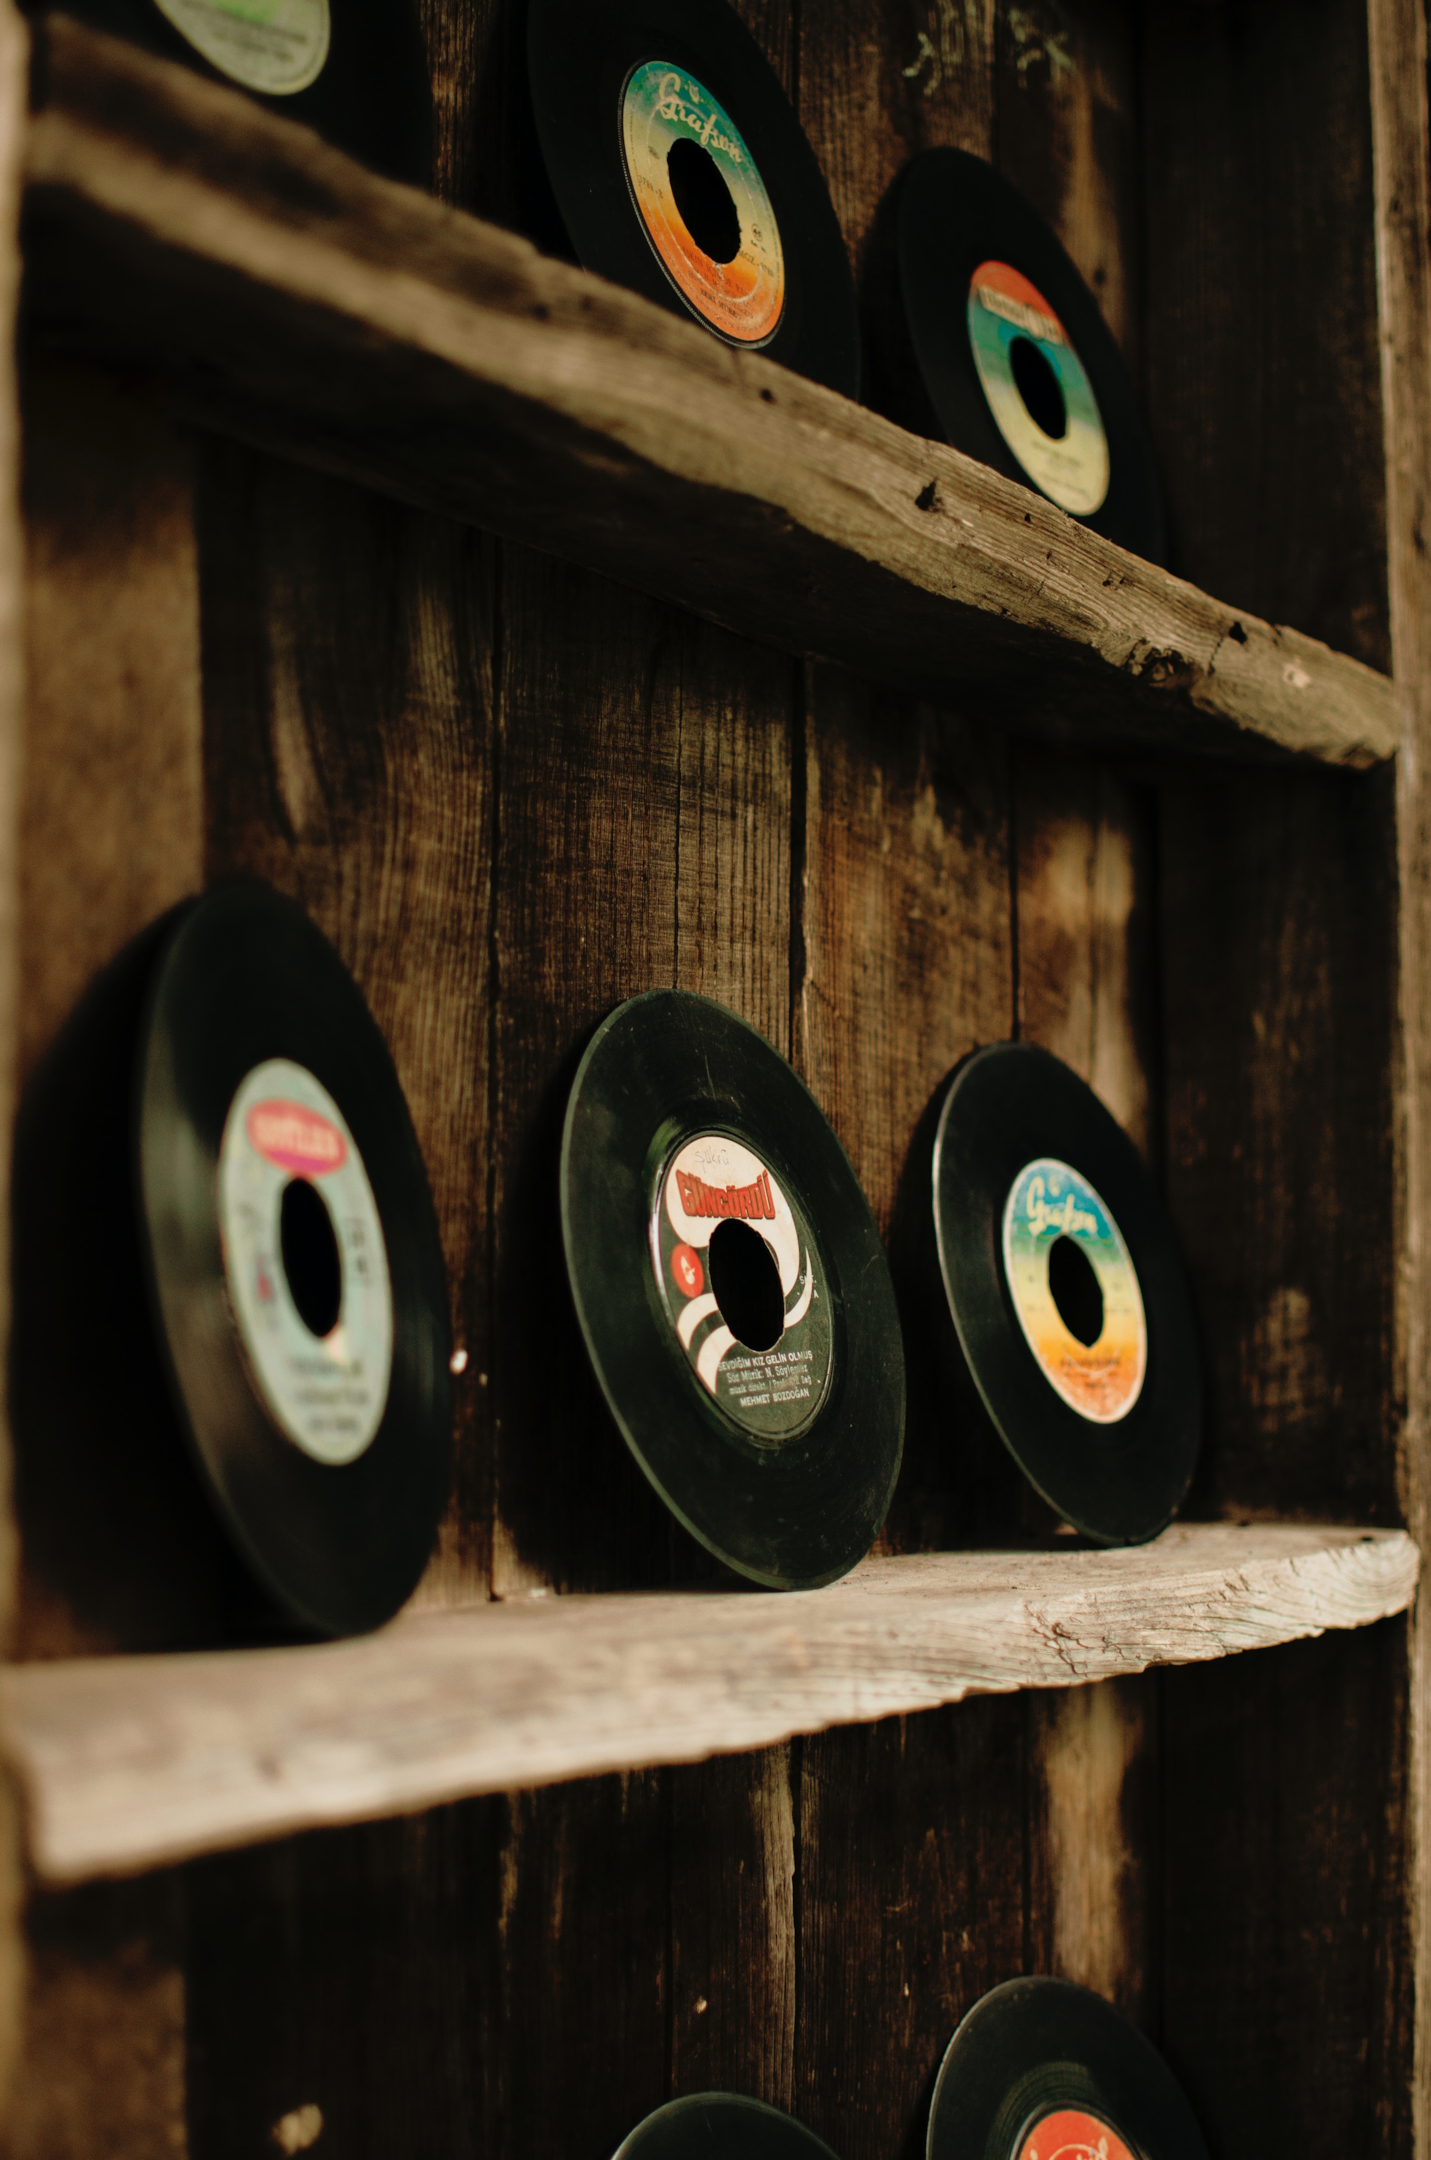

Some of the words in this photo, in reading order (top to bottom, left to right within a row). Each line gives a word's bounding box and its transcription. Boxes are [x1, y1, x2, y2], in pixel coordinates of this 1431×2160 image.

[659, 72, 743, 163] Grafson
[675, 1168, 776, 1220] GÜNGÖRDÜ
[766, 1352, 787, 1365] GELİN
[765, 1367, 775, 1378] N.
[740, 1393, 771, 1407] MEHMET
[772, 1387, 810, 1402] BOZDOĞAN
